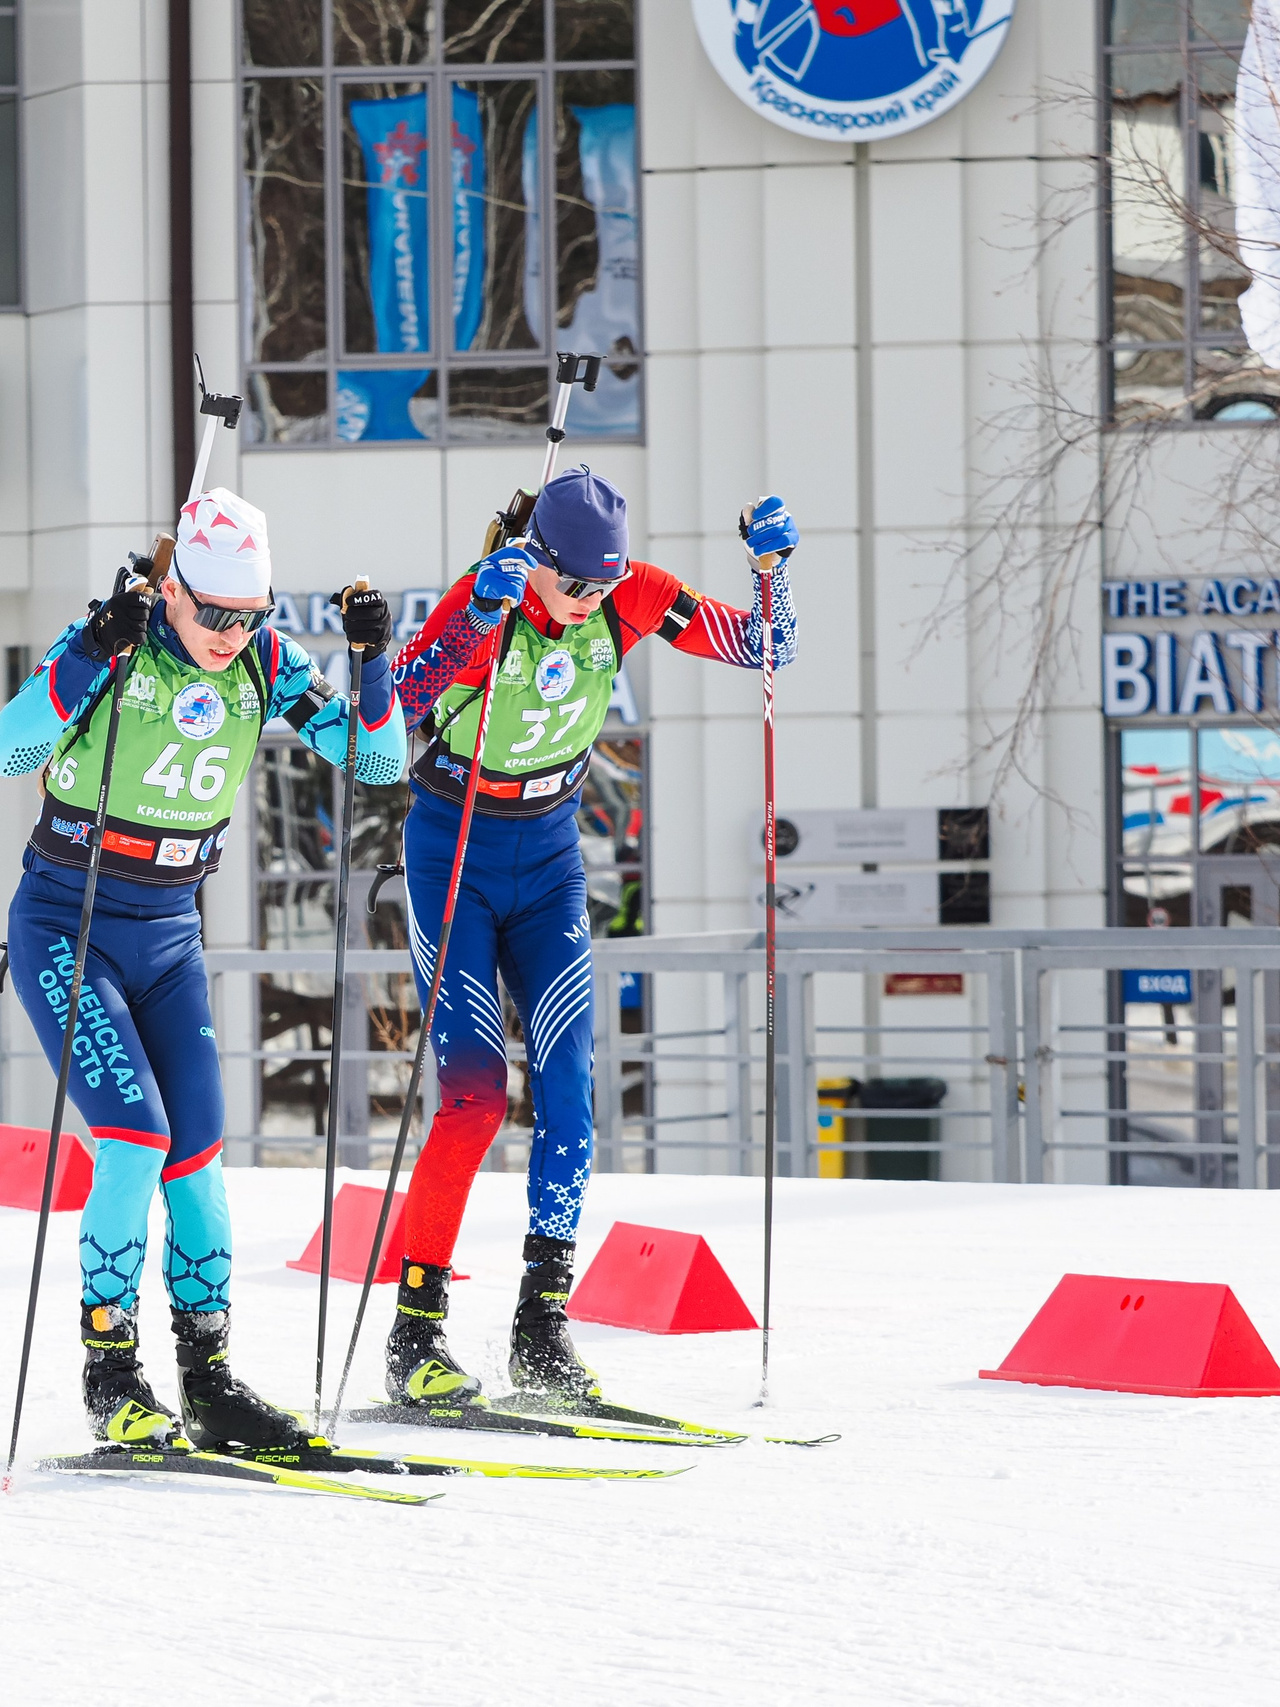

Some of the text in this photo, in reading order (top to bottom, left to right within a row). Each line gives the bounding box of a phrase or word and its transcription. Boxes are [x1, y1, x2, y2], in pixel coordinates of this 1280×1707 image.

[750, 68, 961, 134] Красноярский край
[354, 591, 382, 604] MOAX
[1102, 580, 1188, 618] THE
[1103, 628, 1280, 717] BIAT
[509, 695, 588, 754] 37
[348, 734, 357, 766] MOAX
[504, 744, 574, 769] КРАСНОЯРСК
[141, 742, 231, 802] 46
[137, 805, 215, 822] КРАСНОЯРСК
[71, 960, 82, 995] MOAX
[1138, 974, 1188, 994] ВХОД
[396, 1304, 444, 1320] FISCHER
[84, 1338, 135, 1349] FISCHER
[429, 1408, 463, 1418] FISCHER
[132, 1454, 164, 1463] FISCHER
[255, 1454, 300, 1463] FISCHER
